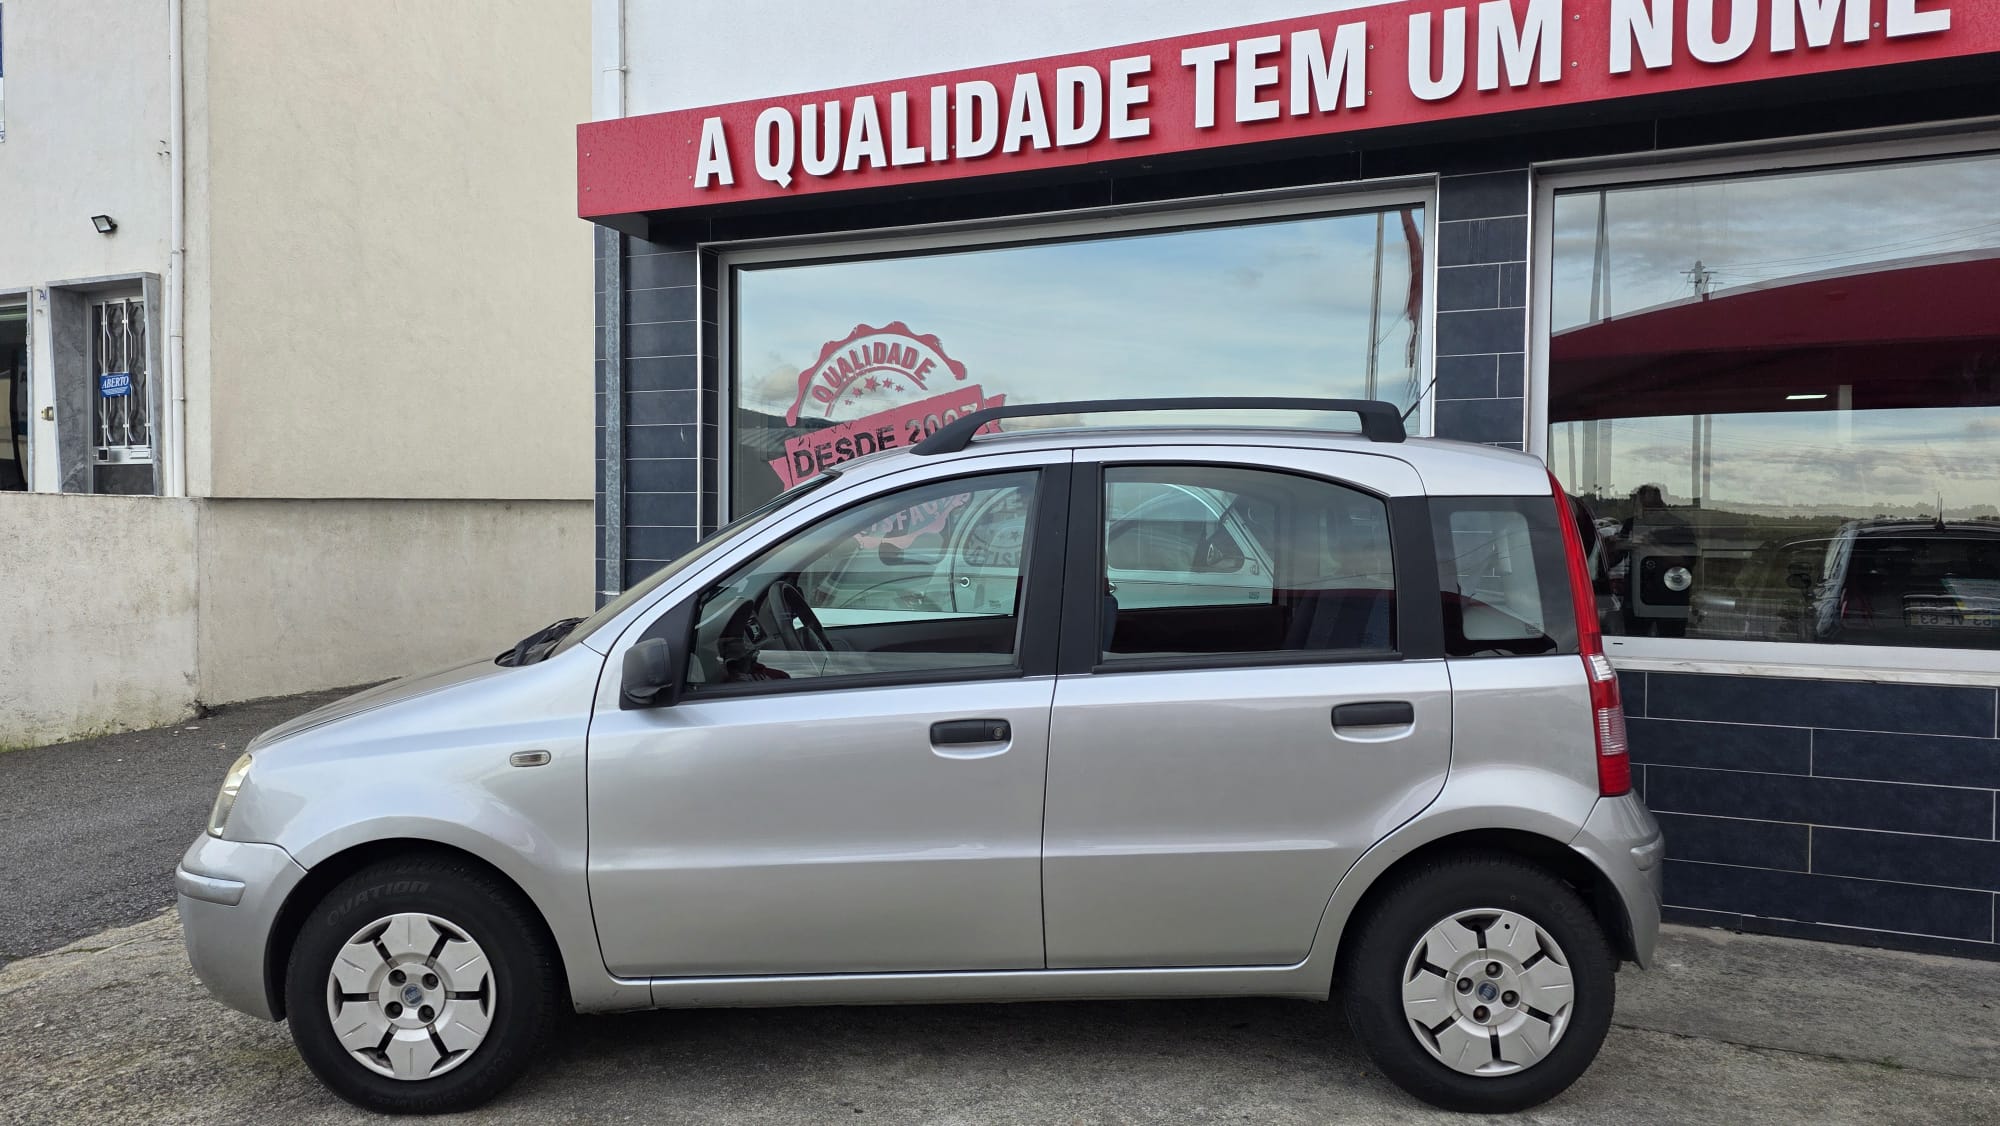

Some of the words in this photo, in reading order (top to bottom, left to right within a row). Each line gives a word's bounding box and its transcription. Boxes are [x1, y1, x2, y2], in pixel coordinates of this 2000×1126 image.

[694, 117, 734, 188] A
[754, 55, 1151, 188] QUALIDADE
[1181, 21, 1366, 128] TEM
[1409, 0, 1562, 100] UM
[103, 376, 129, 388] ABERTO
[811, 341, 937, 403] QUALIDADE
[793, 425, 898, 478] DESDE
[327, 881, 430, 926] OVATION
